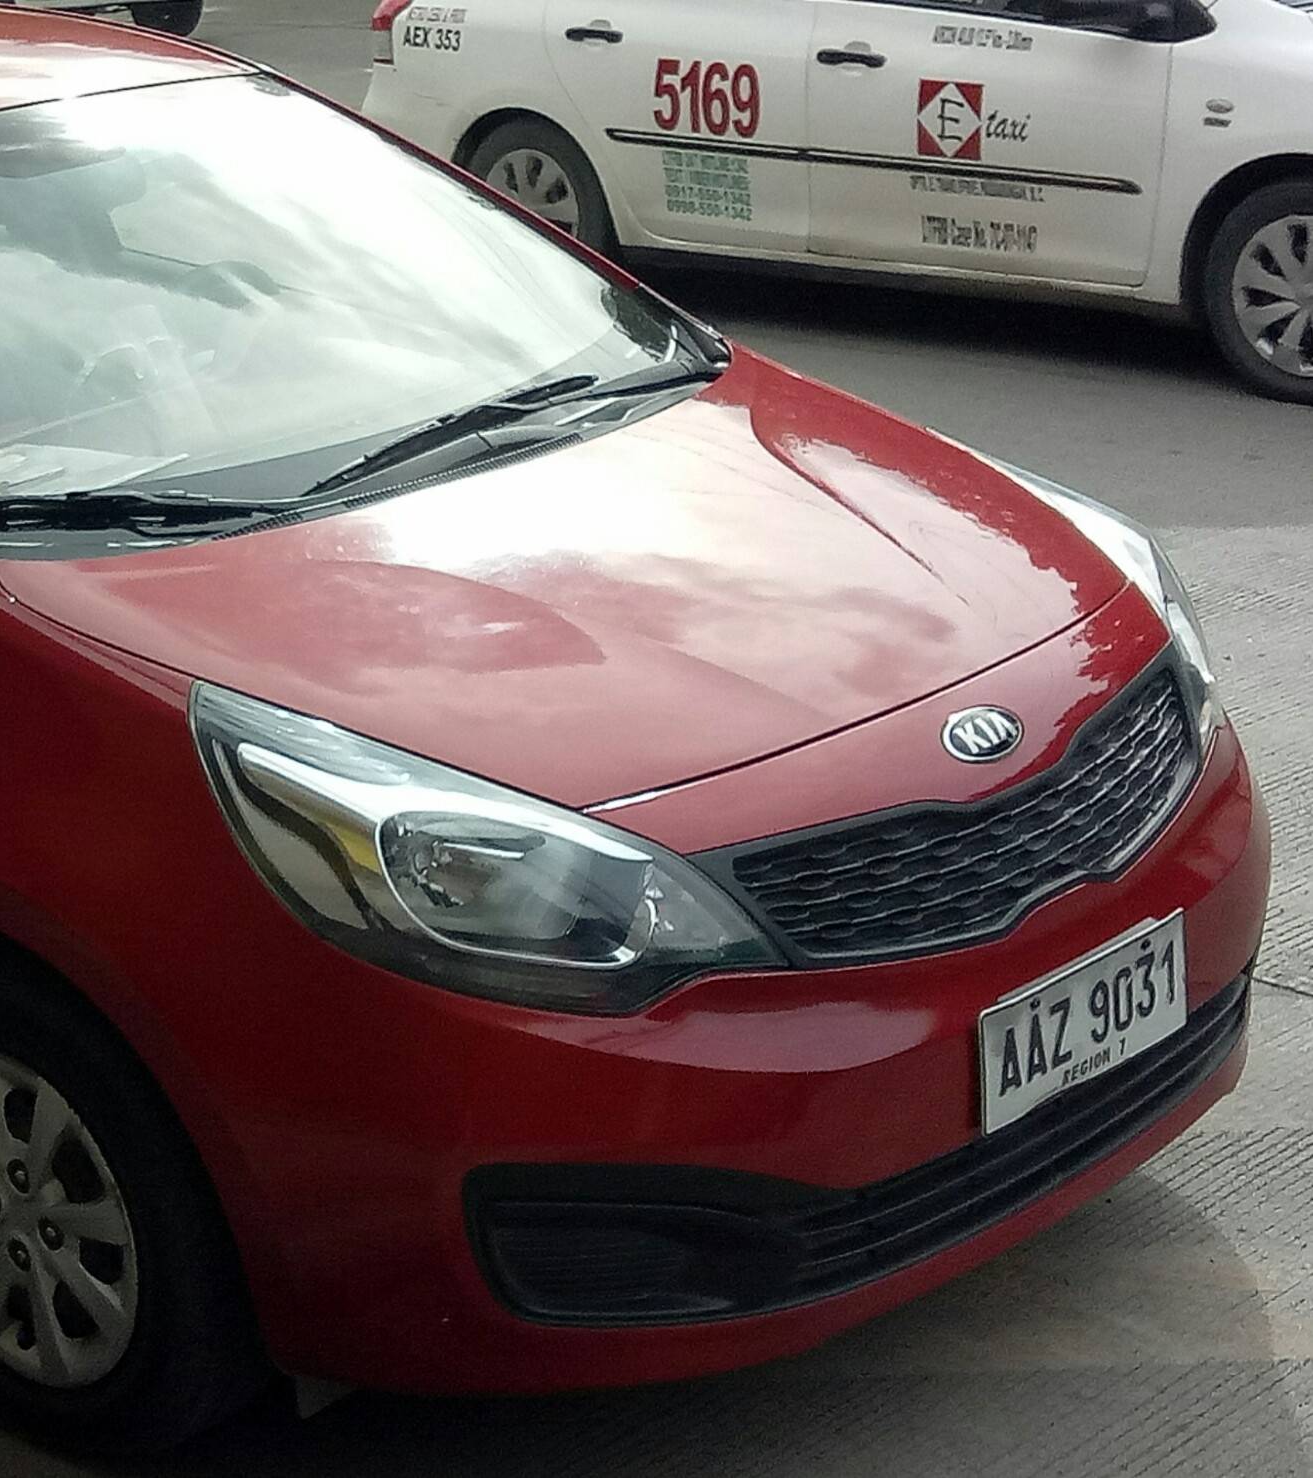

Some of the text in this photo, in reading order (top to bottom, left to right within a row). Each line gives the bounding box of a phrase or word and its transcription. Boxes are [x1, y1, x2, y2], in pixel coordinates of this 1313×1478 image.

[403, 26, 461, 52] AEX 353
[653, 58, 761, 139] 5169
[937, 97, 1031, 143] E taxi
[952, 711, 1018, 755] KIA
[999, 939, 1177, 1098] AAZ 9031
[1061, 1036, 1126, 1087] REGION 7
